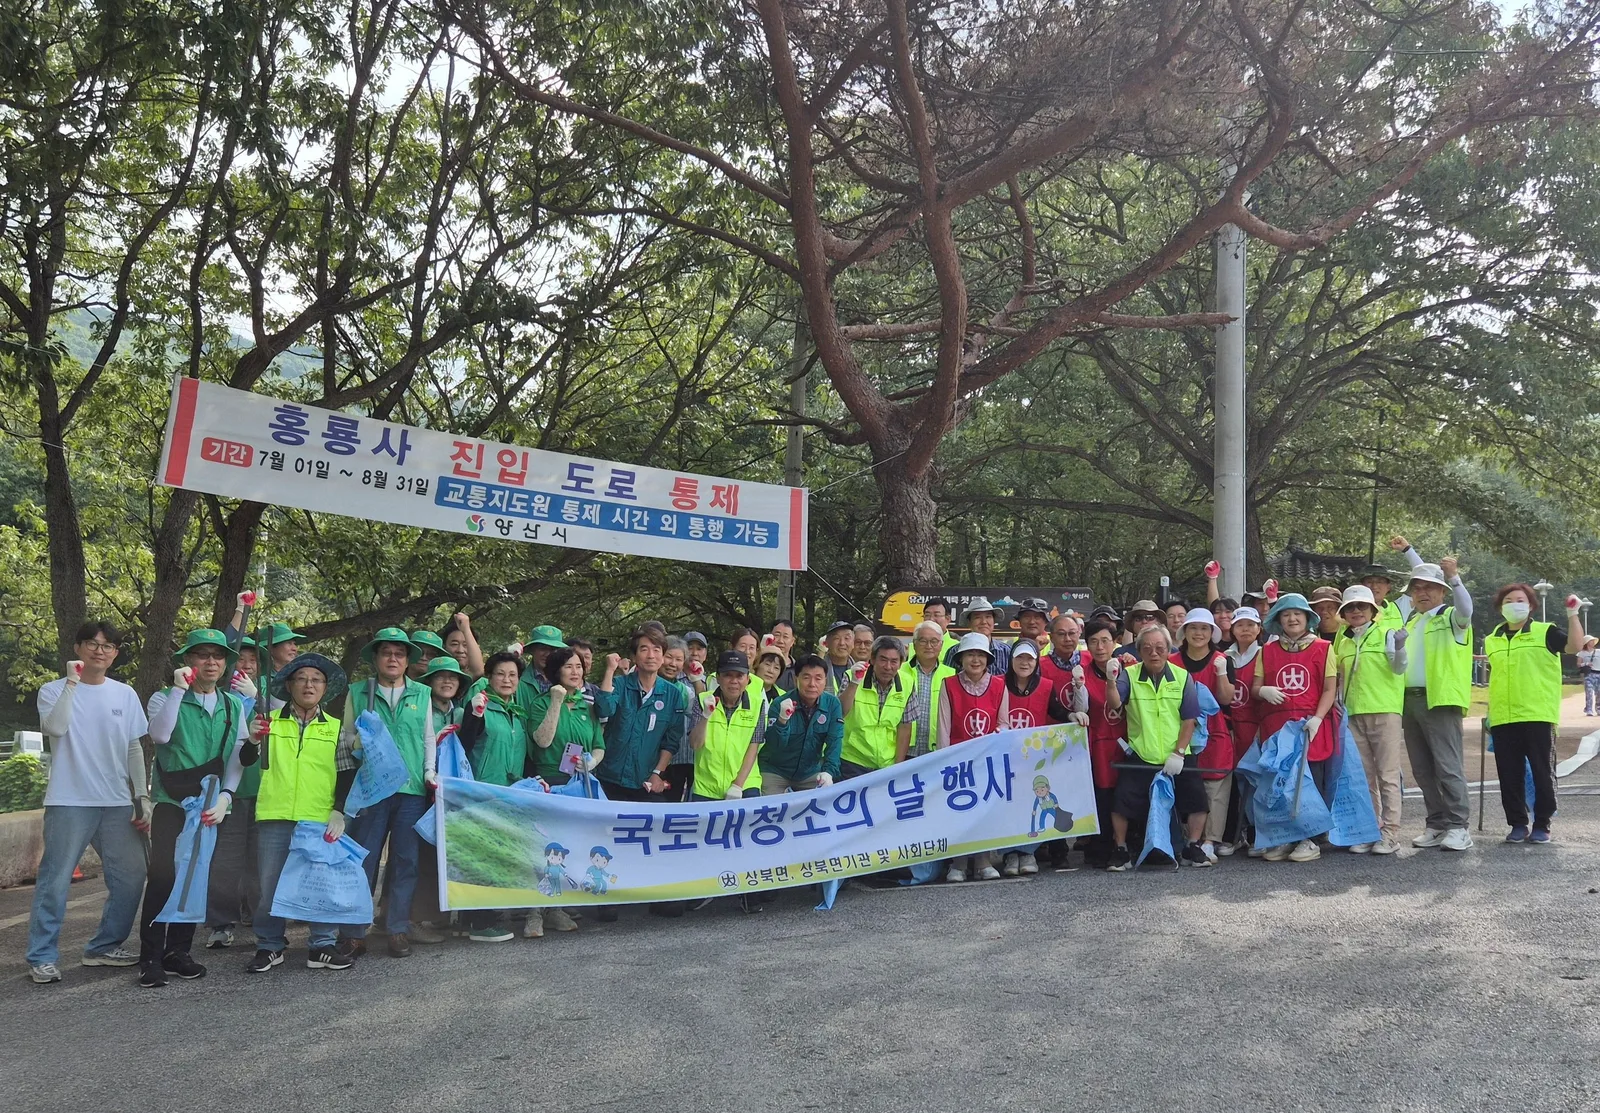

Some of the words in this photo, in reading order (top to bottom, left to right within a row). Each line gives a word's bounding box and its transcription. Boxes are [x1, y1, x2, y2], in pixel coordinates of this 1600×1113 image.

[209, 441, 247, 465] 기간
[259, 451, 285, 471] 7월
[294, 457, 330, 479] 01일
[362, 469, 388, 489] 8월
[396, 476, 429, 496] 31일
[268, 404, 412, 465] 홍룡사
[450, 440, 529, 486] 진입
[561, 462, 638, 500] 도로
[668, 477, 740, 516] 통제
[443, 482, 551, 517] 교통지도원
[560, 499, 600, 525] 통제
[611, 507, 649, 531] 시간
[659, 513, 677, 535] 외
[688, 517, 724, 540] 통행
[734, 522, 769, 545] 가능
[495, 518, 567, 544] 양산시
[612, 785, 874, 856] 국토대청소의
[888, 773, 926, 821] 날
[940, 753, 1015, 811] 행사
[745, 866, 795, 887] 상북면,
[800, 848, 871, 879] 상북면기관
[877, 848, 890, 864] 및
[897, 837, 949, 861] 사회단체
